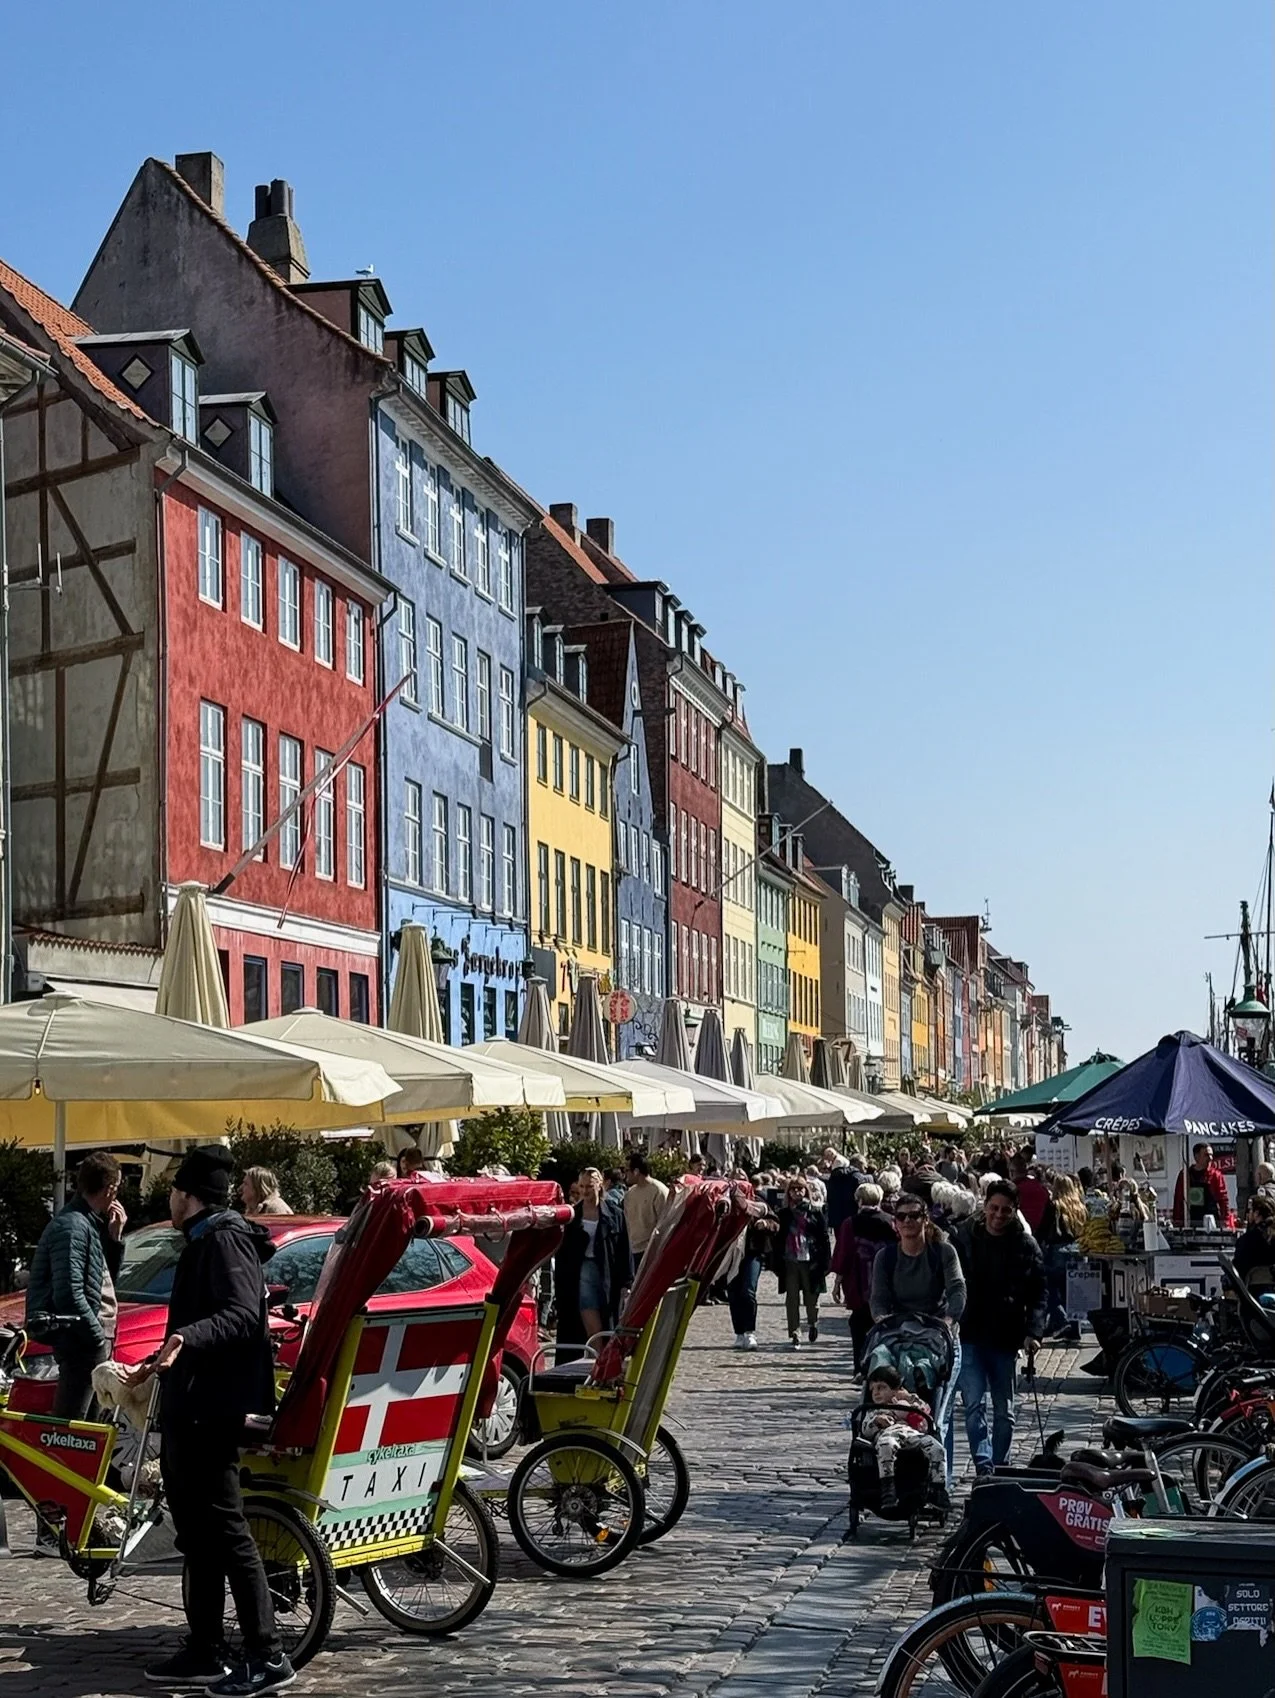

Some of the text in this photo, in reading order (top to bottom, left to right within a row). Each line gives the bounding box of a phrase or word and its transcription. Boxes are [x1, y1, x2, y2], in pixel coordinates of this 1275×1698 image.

[1095, 1116, 1143, 1131] CRÊPES
[1183, 1119, 1256, 1136] PANCAKES
[40, 1432, 97, 1451] cykeltaxa
[366, 1443, 417, 1465] cykeltaxa
[341, 1462, 427, 1501] TAXI
[1059, 1497, 1093, 1515] PRØV
[1066, 1512, 1110, 1533] GRATIS
[1236, 1589, 1260, 1599] SOLO
[1155, 1605, 1174, 1615] KBH
[1227, 1603, 1269, 1612] SETTORE
[1152, 1622, 1178, 1632] TORV
